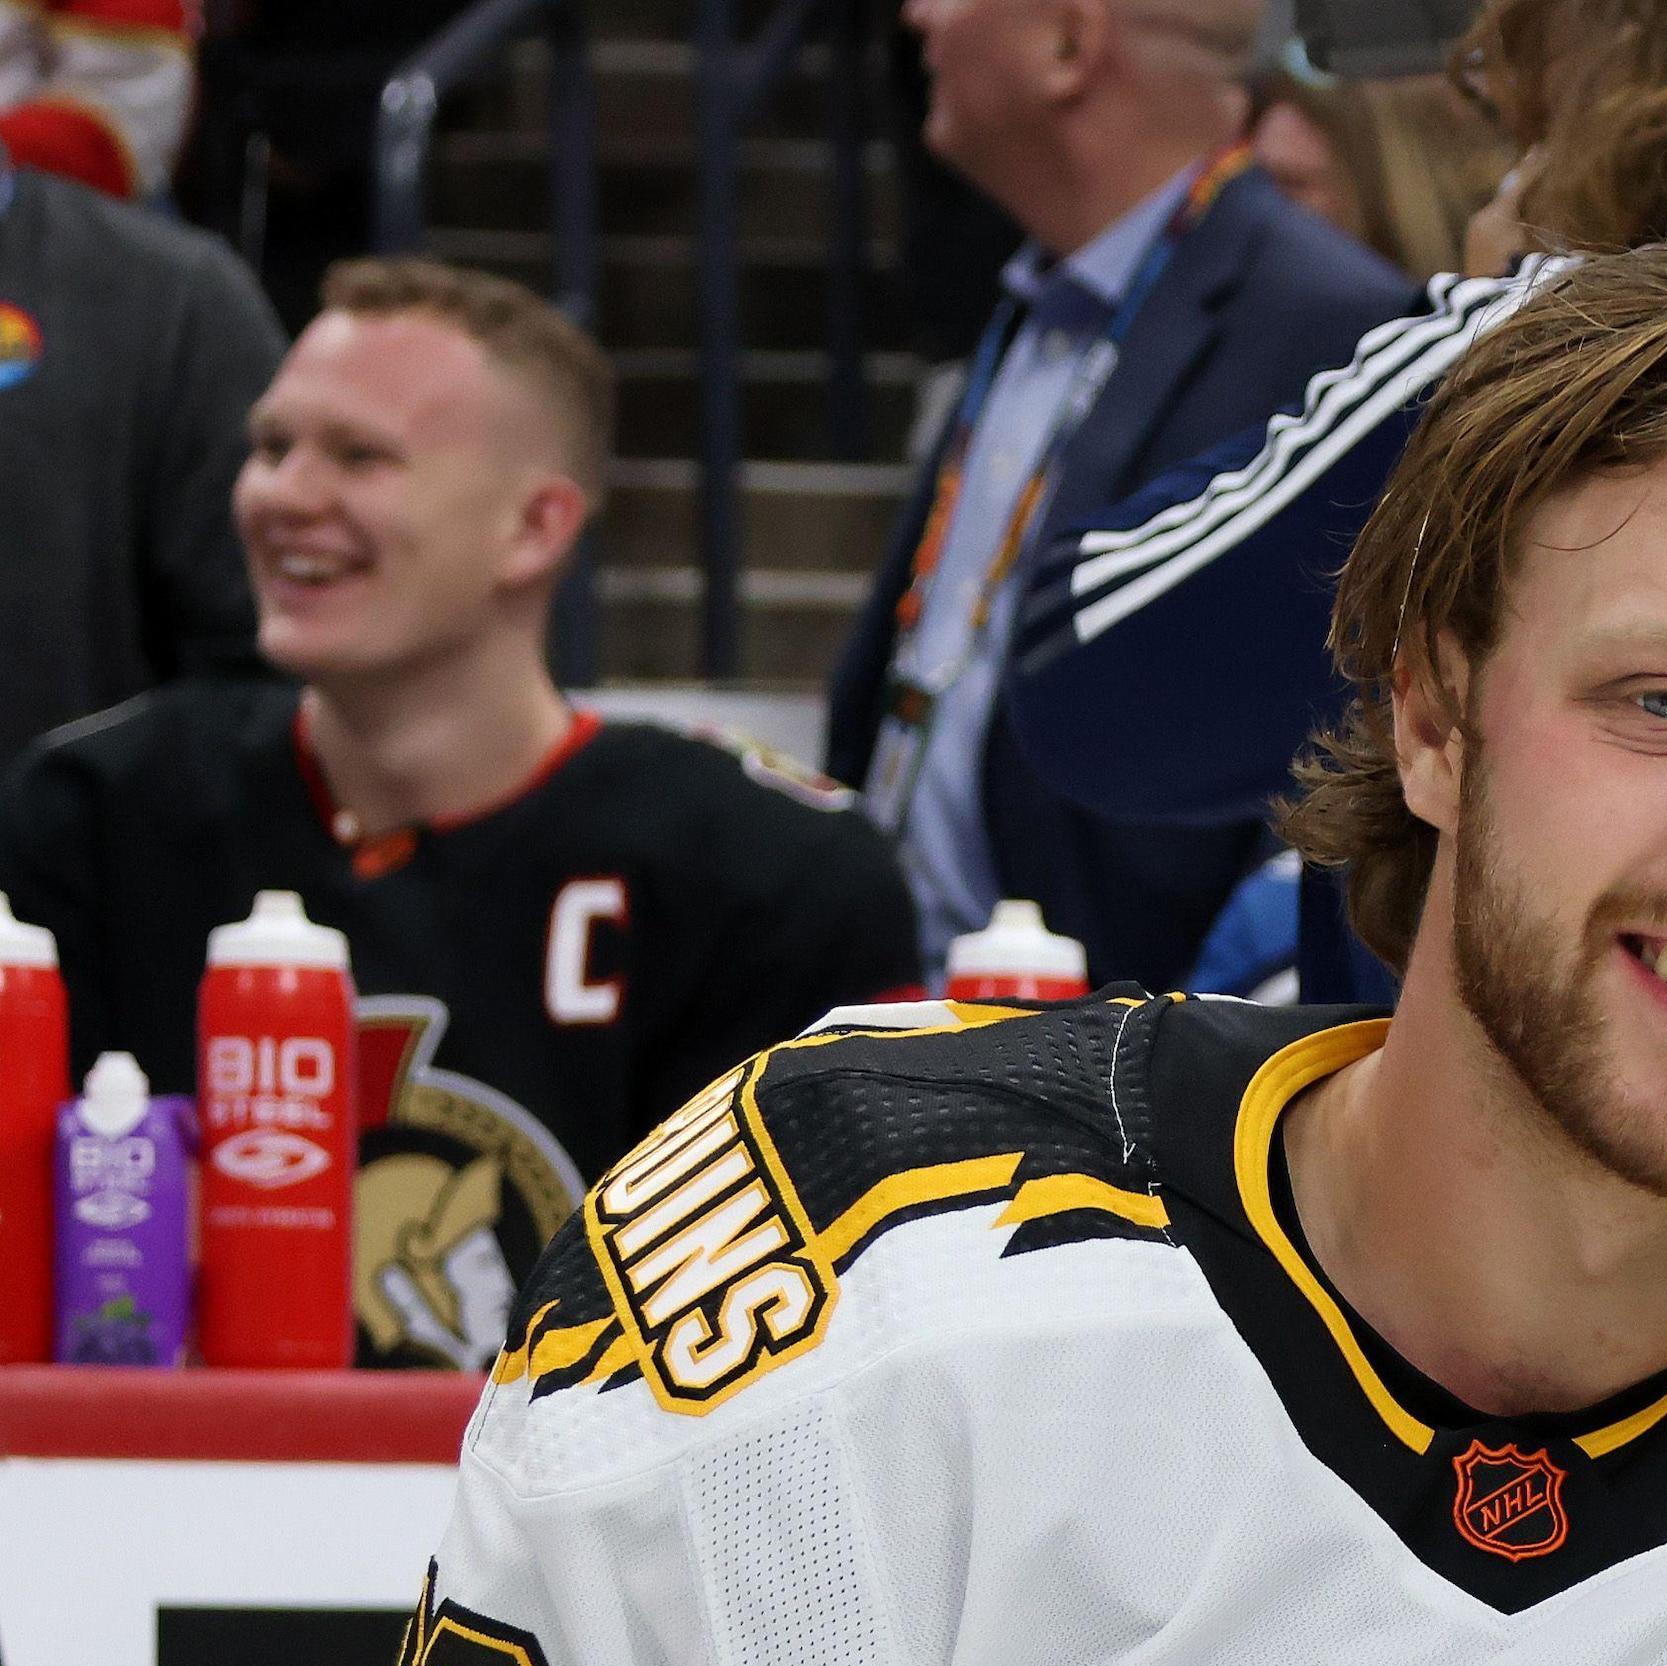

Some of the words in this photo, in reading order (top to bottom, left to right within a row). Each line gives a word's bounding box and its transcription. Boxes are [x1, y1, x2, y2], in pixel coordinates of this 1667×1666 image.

[543, 874, 632, 1027] C
[208, 1036, 336, 1098] BIO
[1480, 1479, 1544, 1532] NHL
